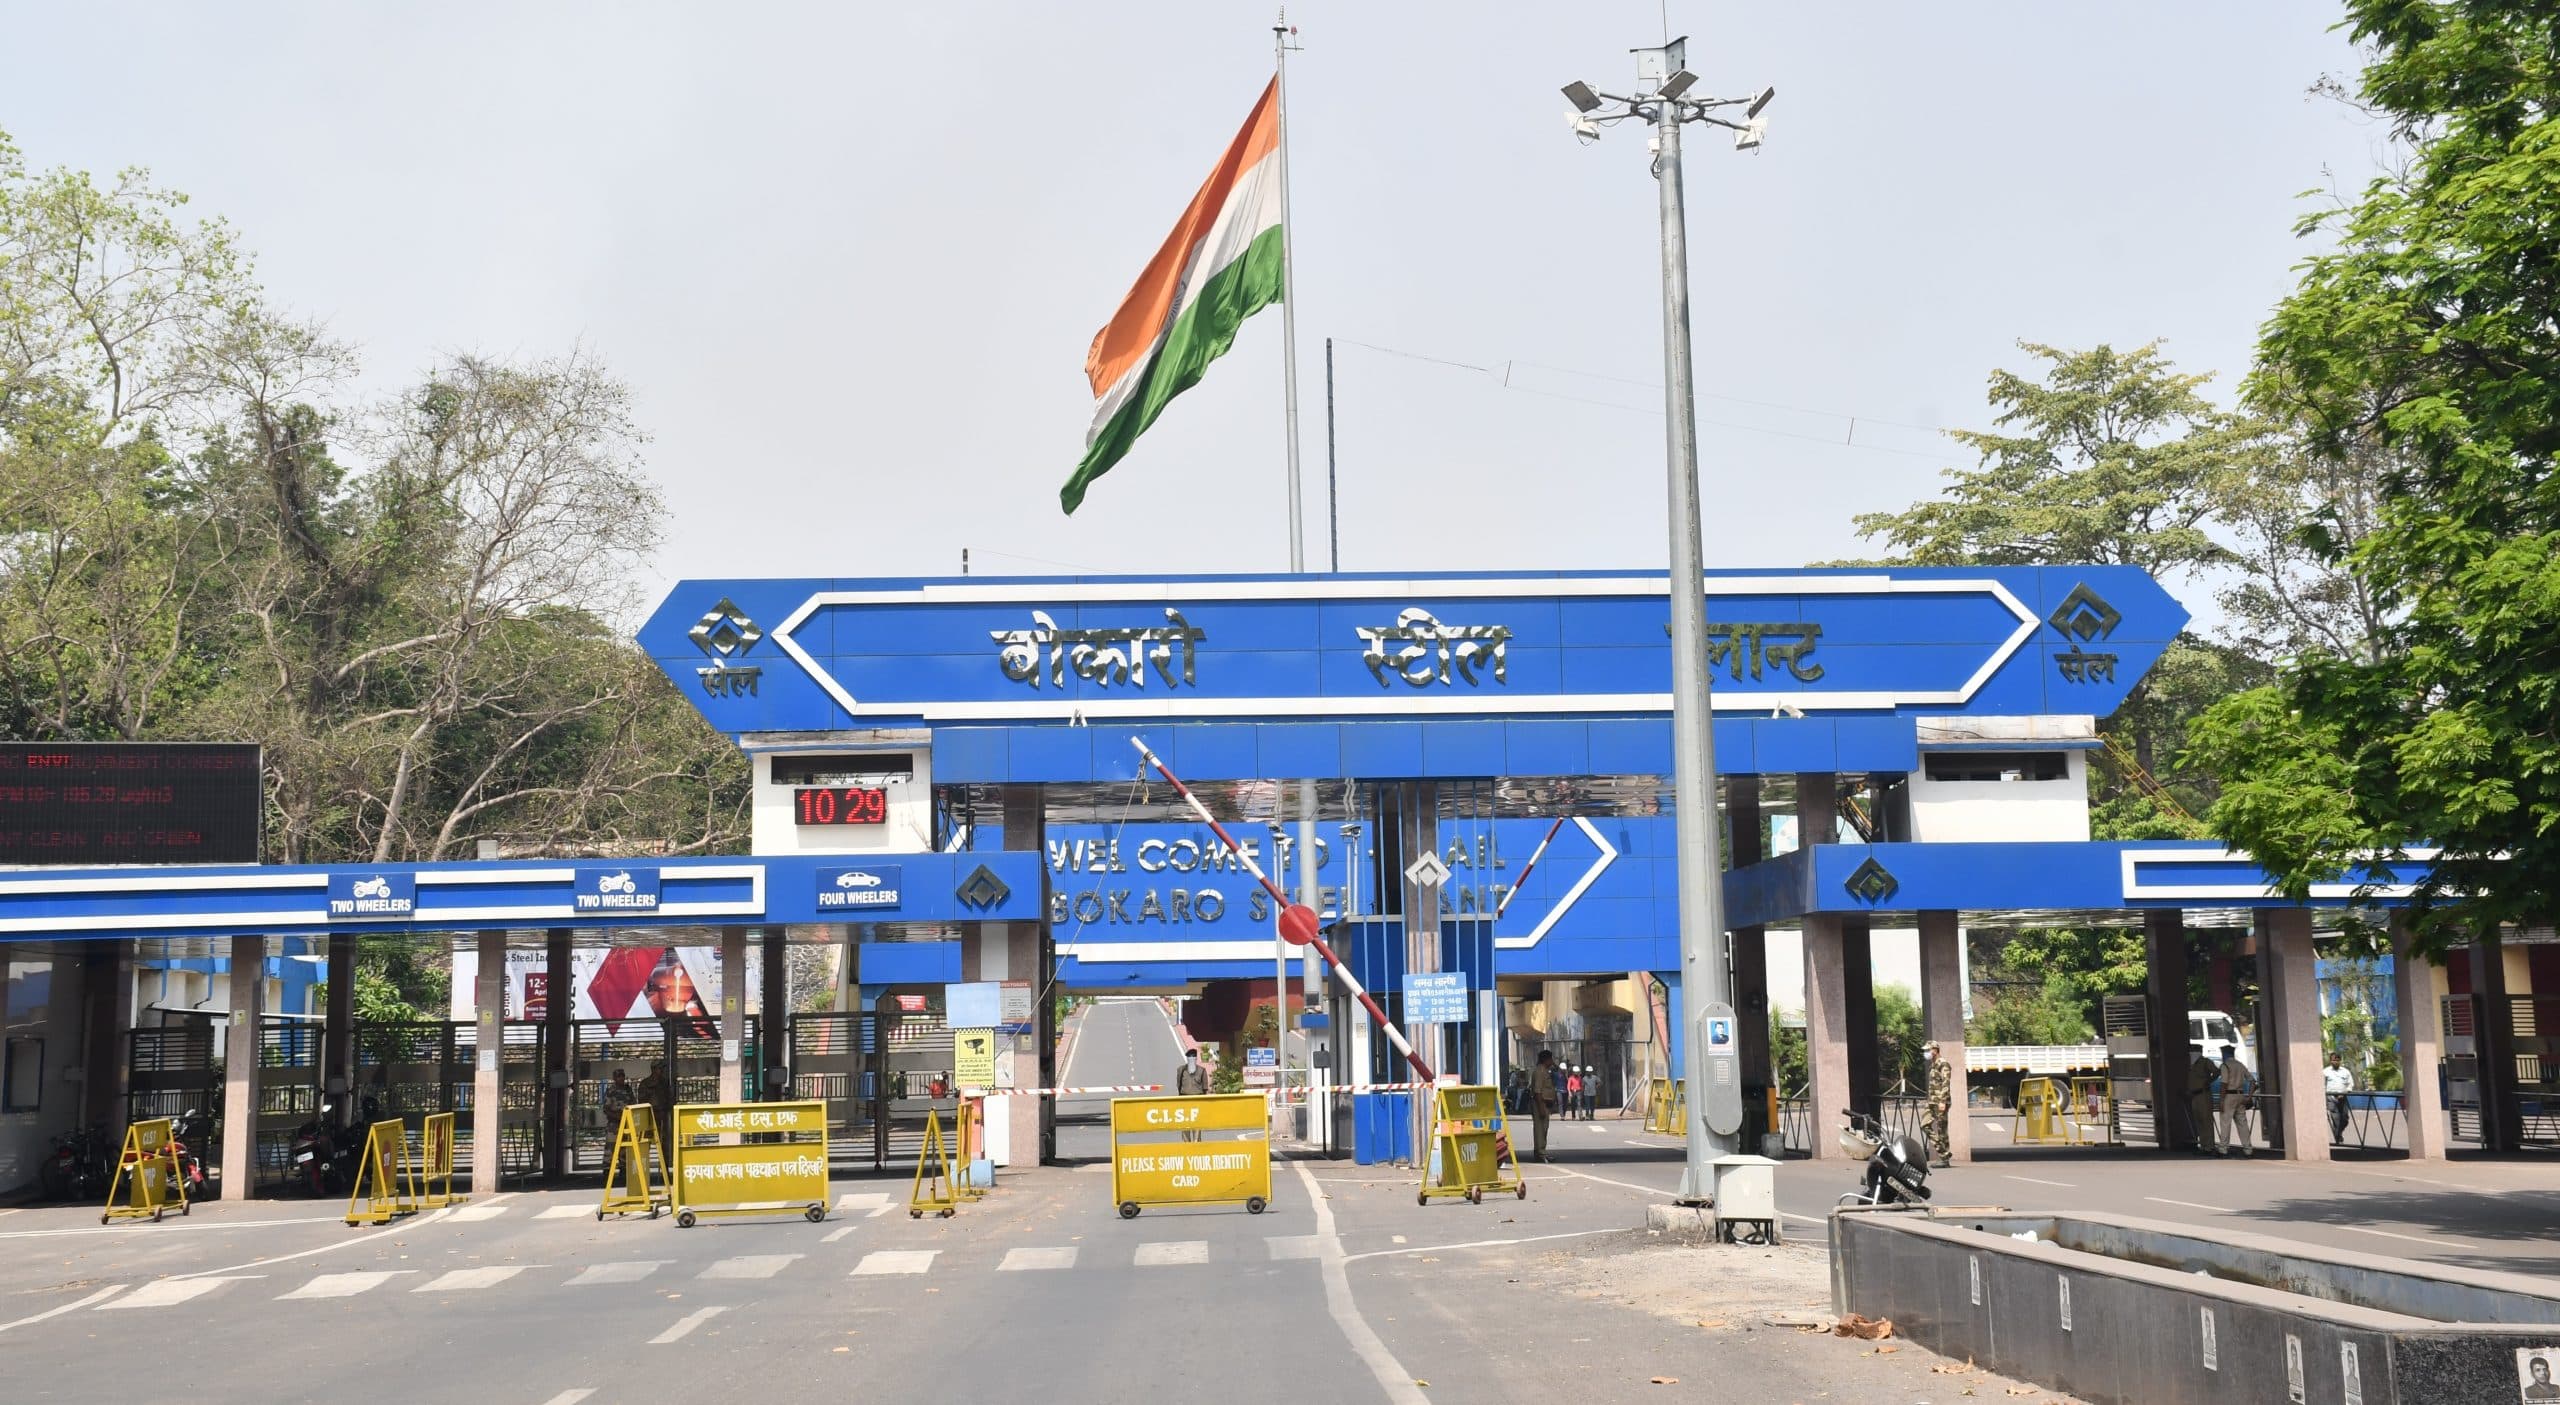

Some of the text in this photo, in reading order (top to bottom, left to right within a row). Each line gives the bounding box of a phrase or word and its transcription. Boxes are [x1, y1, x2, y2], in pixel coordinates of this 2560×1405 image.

[989, 608, 1206, 690] बोकारो
[1356, 607, 1513, 688] स्टील
[2053, 644, 2119, 684] सेल
[696, 657, 762, 698] सेल
[800, 788, 885, 824] 10 29
[331, 898, 411, 913] TWO WHEELERS
[577, 894, 656, 907] TWO WHEELERS
[819, 889, 898, 906] FOUR WHEELERS
[1050, 888, 1225, 922] BOKARO
[715, 1163, 744, 1180] अपना
[1122, 1153, 1252, 1174] PLEASE SHOW YOUR IDENTITY
[1172, 1175, 1200, 1188] CARD
